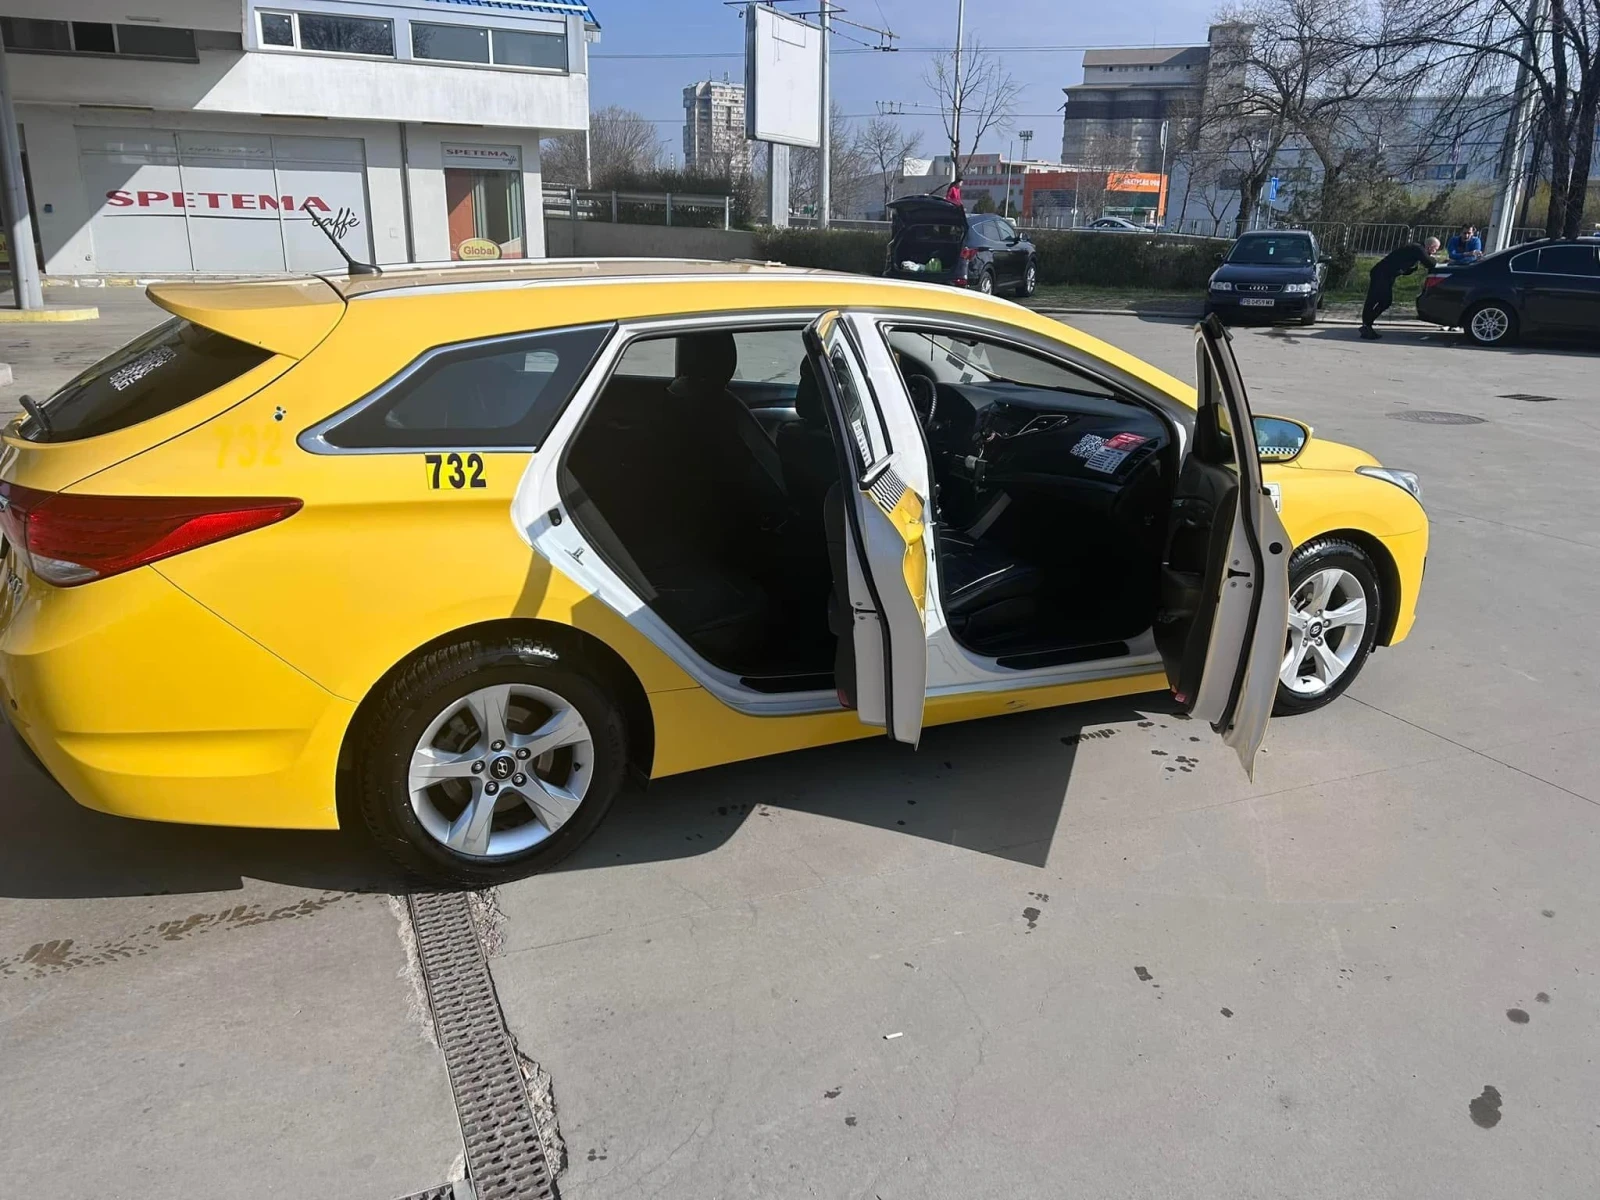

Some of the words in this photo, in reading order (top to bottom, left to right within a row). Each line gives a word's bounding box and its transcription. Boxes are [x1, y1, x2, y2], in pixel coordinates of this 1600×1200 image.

[446, 149, 509, 157] SPETEMA
[106, 190, 331, 212] SPETEMA
[312, 207, 360, 239] caffè
[463, 246, 495, 255] Global
[214, 424, 283, 469] 732
[426, 453, 487, 489] 732
